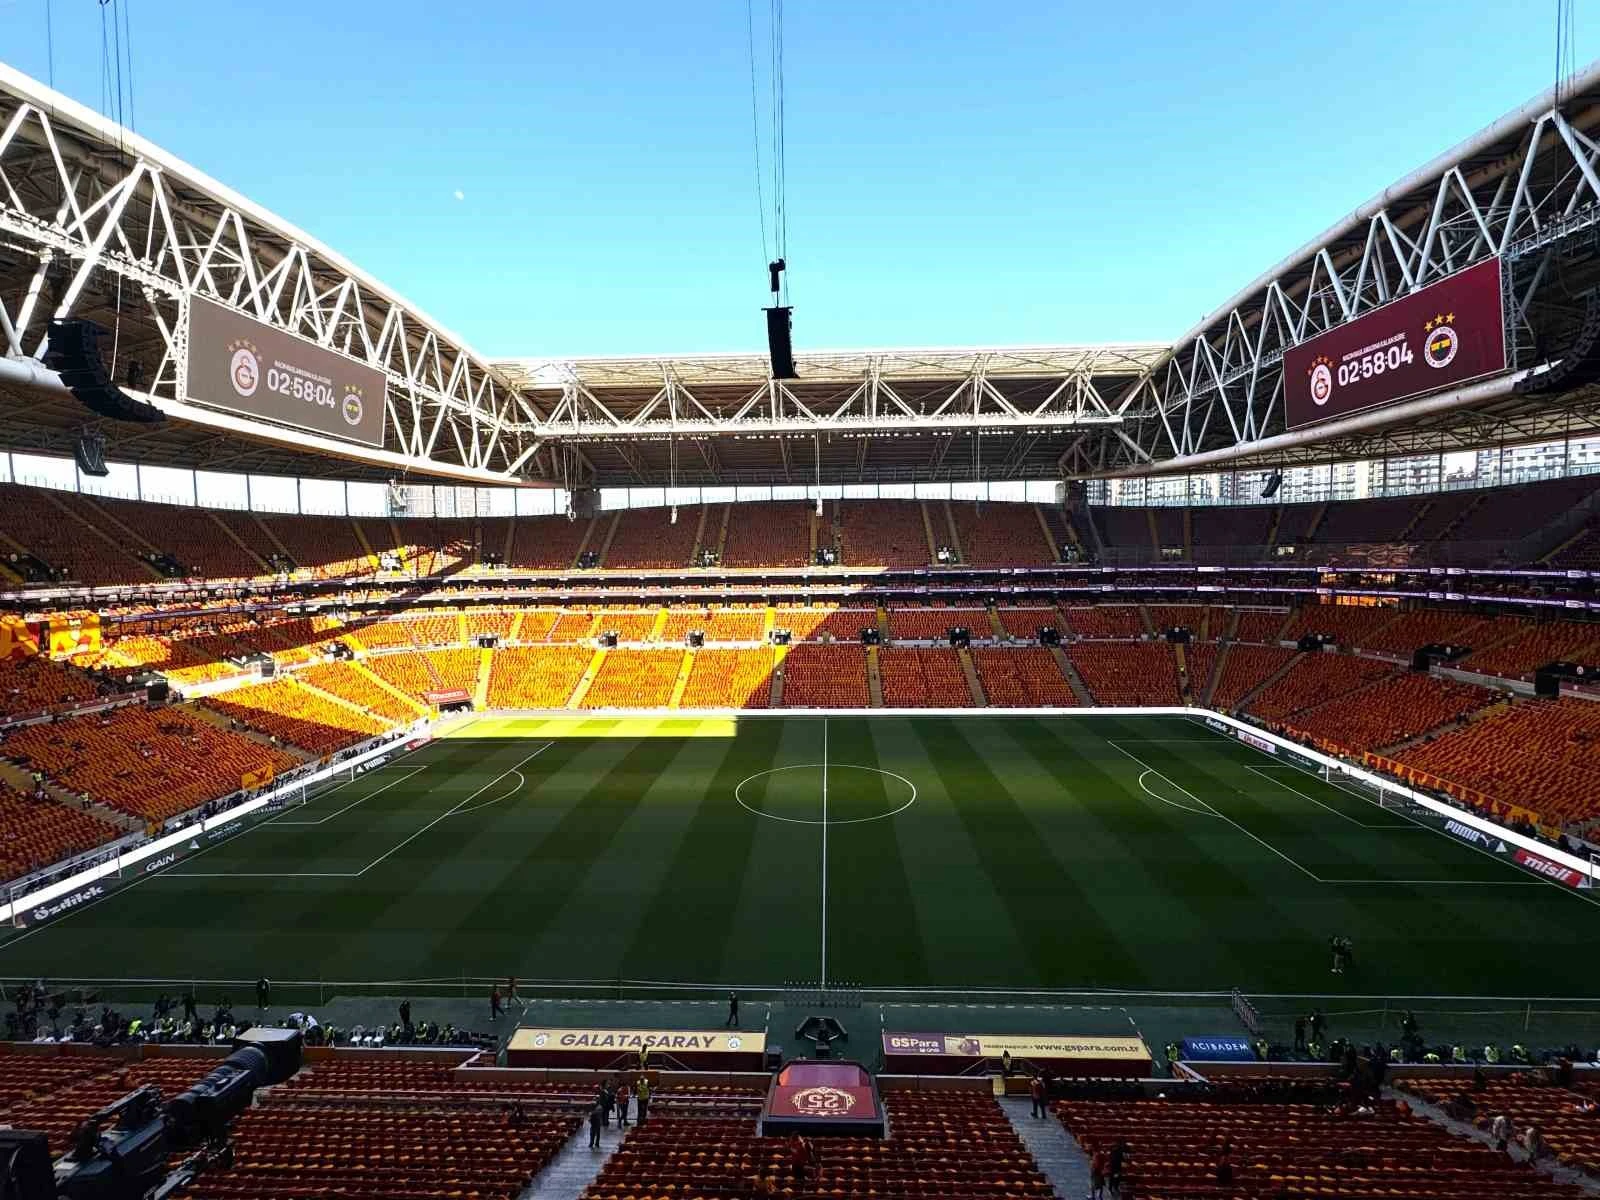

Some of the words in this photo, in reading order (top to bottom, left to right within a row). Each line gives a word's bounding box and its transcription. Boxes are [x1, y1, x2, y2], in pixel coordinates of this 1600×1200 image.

[1338, 342, 1414, 386] 02:58:04
[267, 368, 336, 409] 02:58:04
[1444, 820, 1481, 842] PUMA
[1523, 855, 1574, 881] misli
[560, 1033, 716, 1048] GALATASARAY
[1034, 1044, 1139, 1053] www.gspara.com.tr
